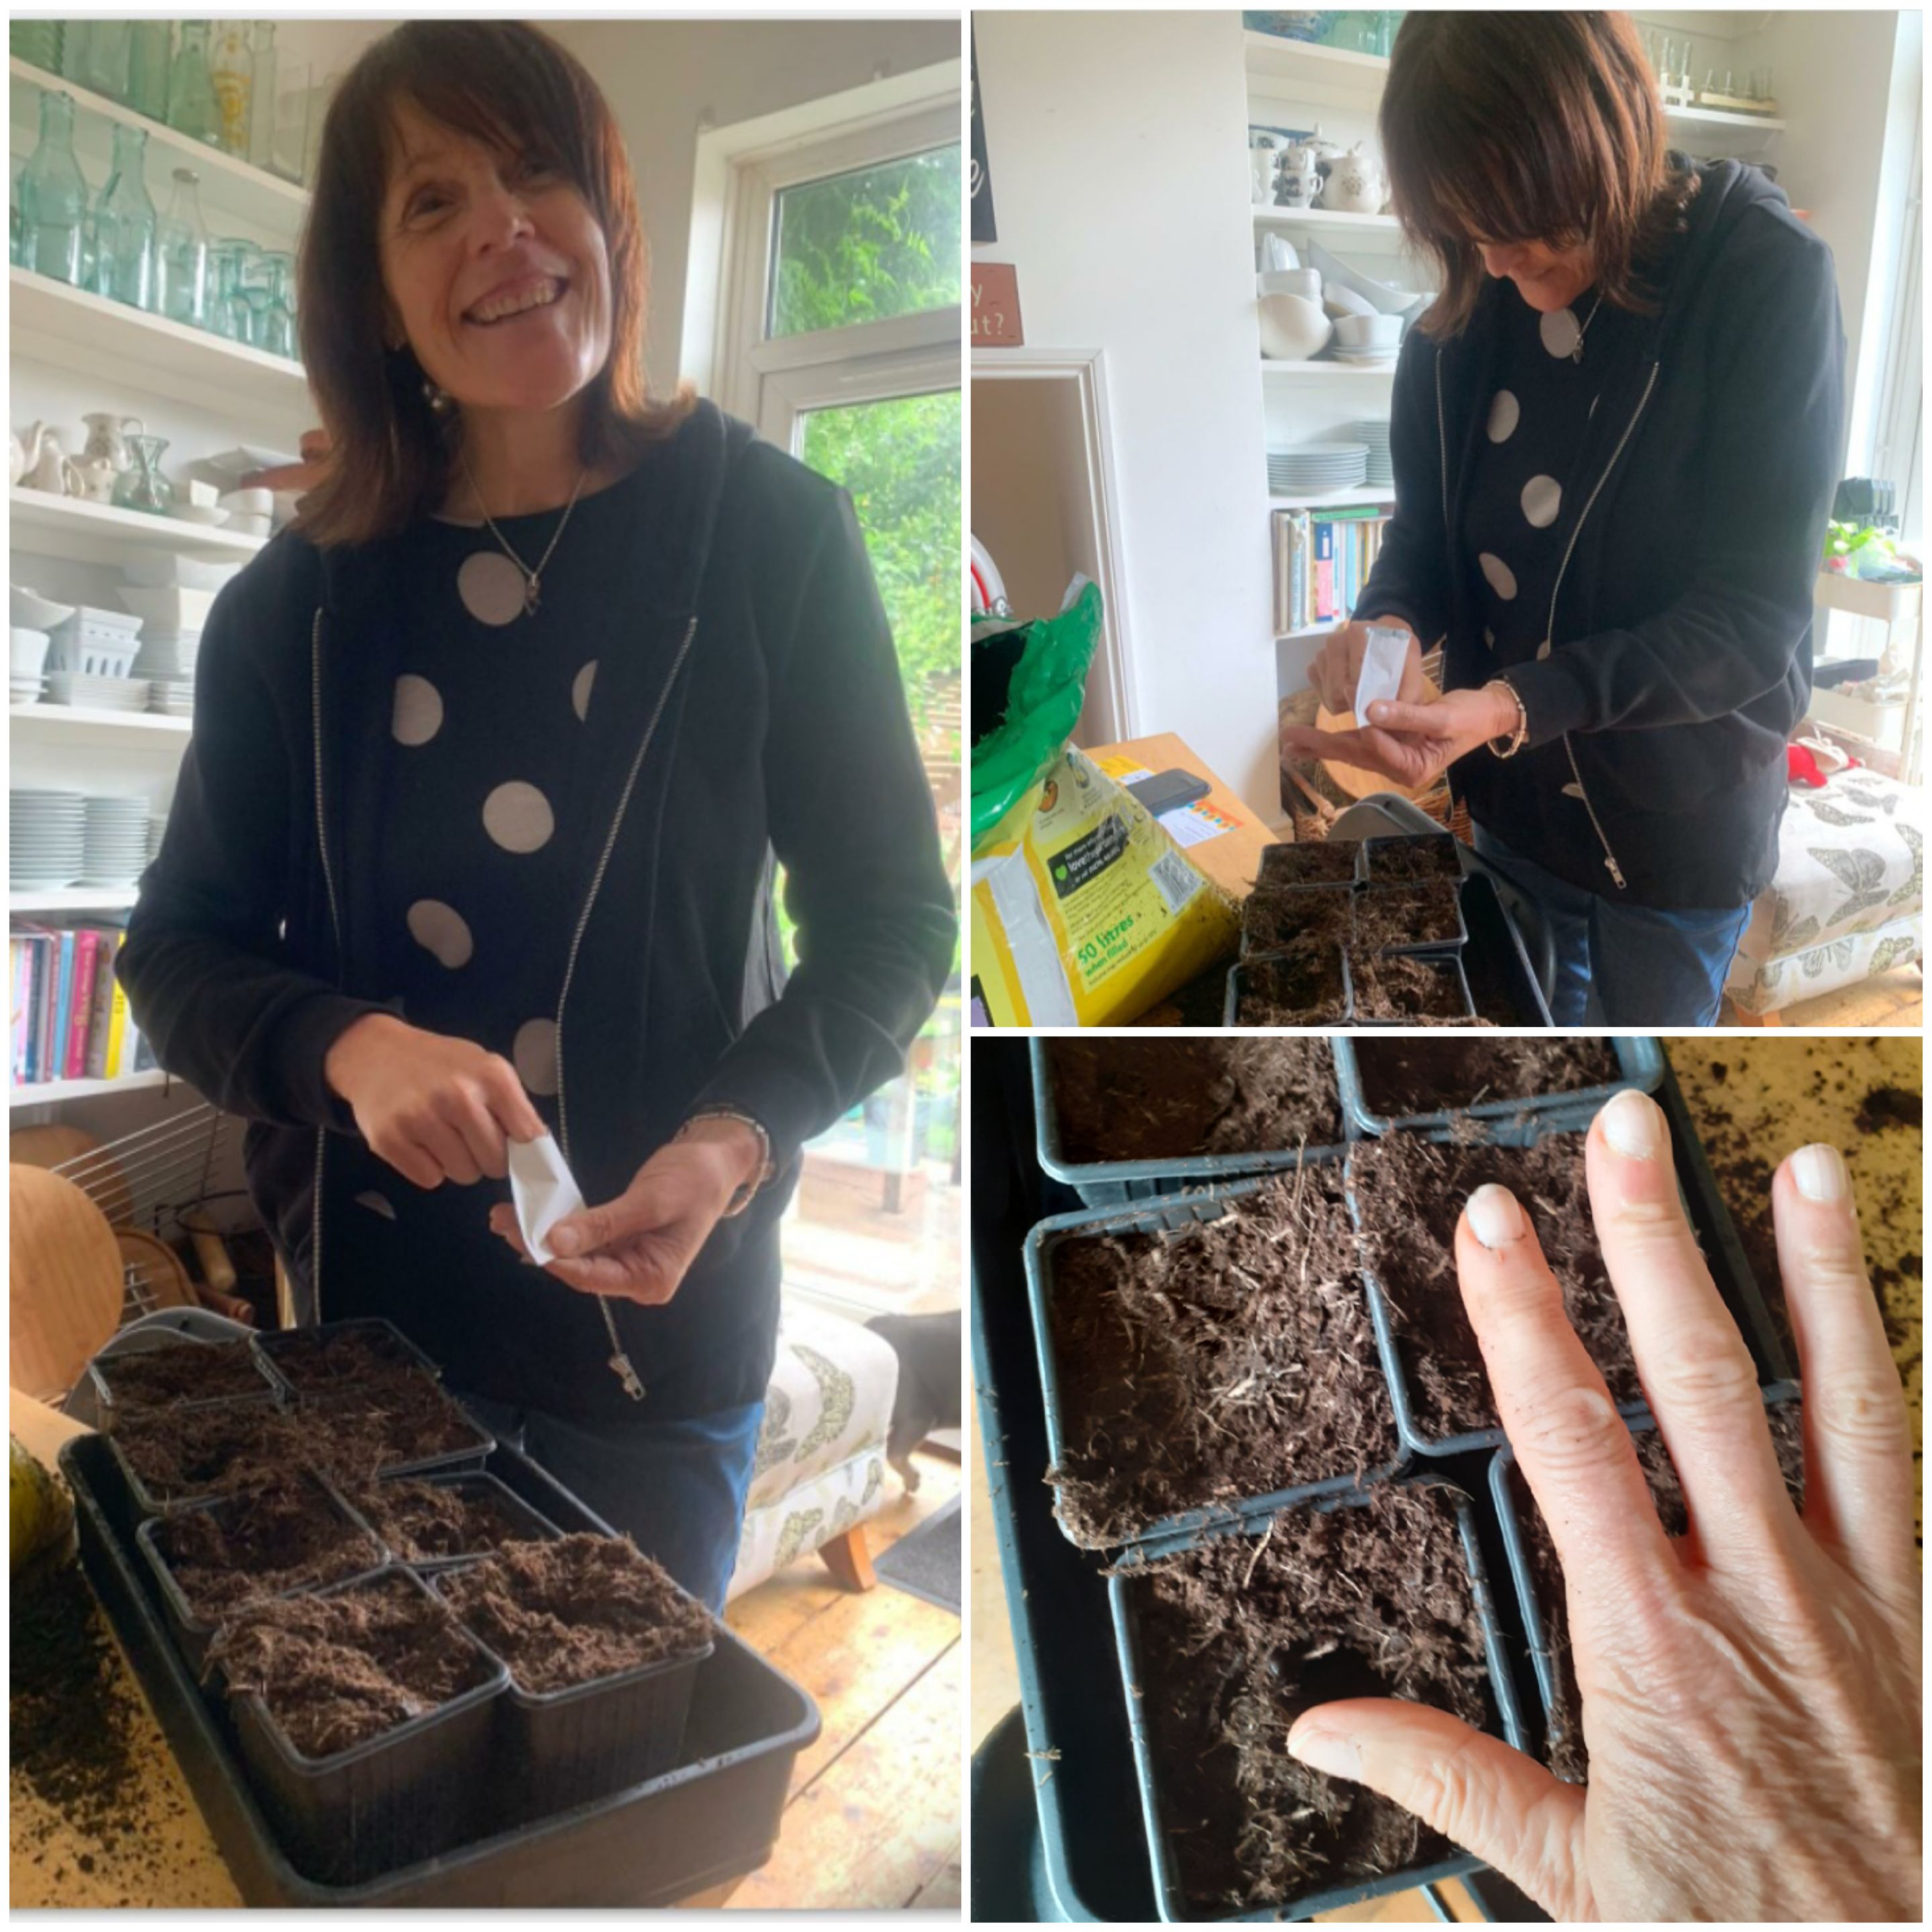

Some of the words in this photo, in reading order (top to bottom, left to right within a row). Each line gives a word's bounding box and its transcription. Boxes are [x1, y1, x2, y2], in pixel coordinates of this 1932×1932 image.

[1077, 942, 1098, 966] 50
[1095, 914, 1134, 949] litres
[1085, 956, 1108, 977] when
[1106, 937, 1129, 960] filled
